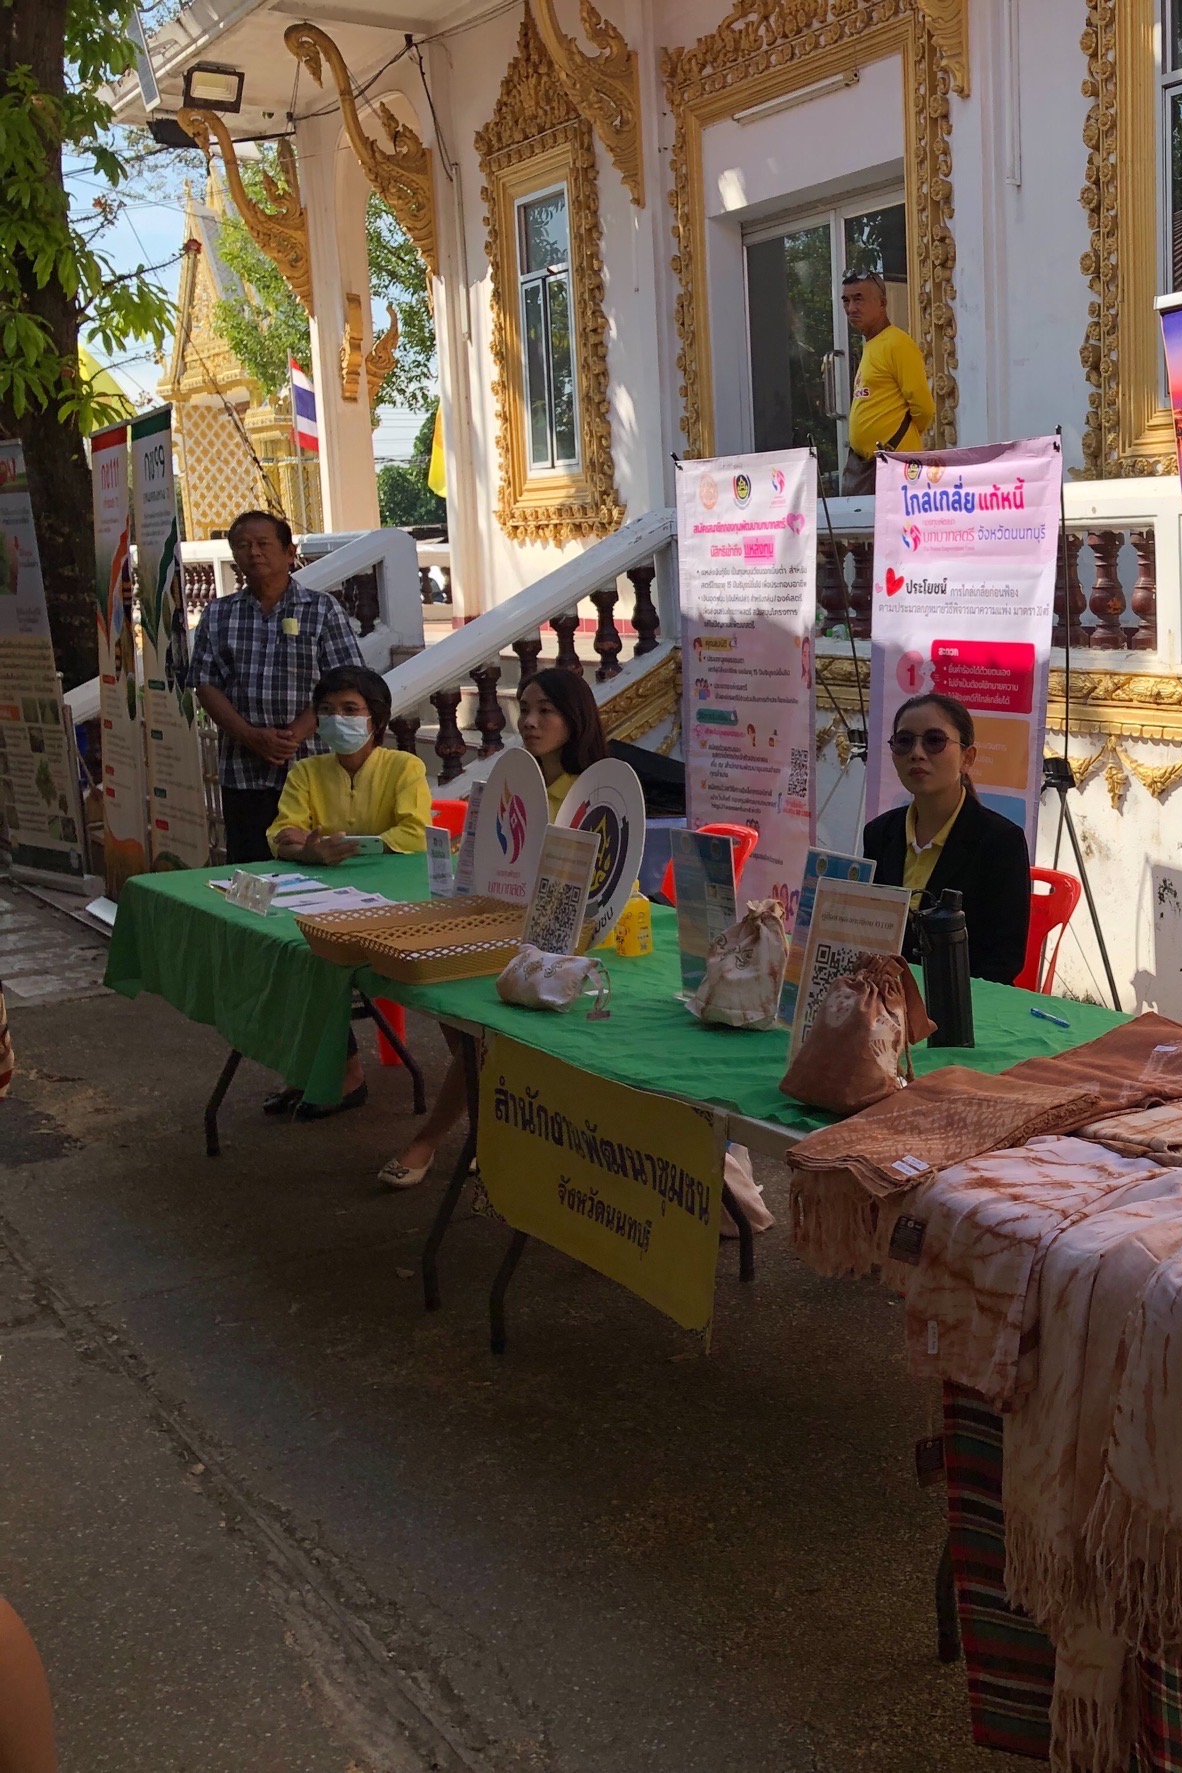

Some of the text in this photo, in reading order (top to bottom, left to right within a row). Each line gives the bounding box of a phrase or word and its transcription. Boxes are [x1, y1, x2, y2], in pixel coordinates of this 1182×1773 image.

[901, 475, 1026, 517] ไกล่เกลี่ย แก้หนี้
[922, 523, 1047, 544] บทบาทสตรี จังหวัดนนทบุรี
[906, 578, 948, 595] ประโยชน์
[494, 1075, 711, 1226] สำนักงานพัฒนาชุมชน
[557, 1174, 653, 1261] จังหวัดนนทบุรี
